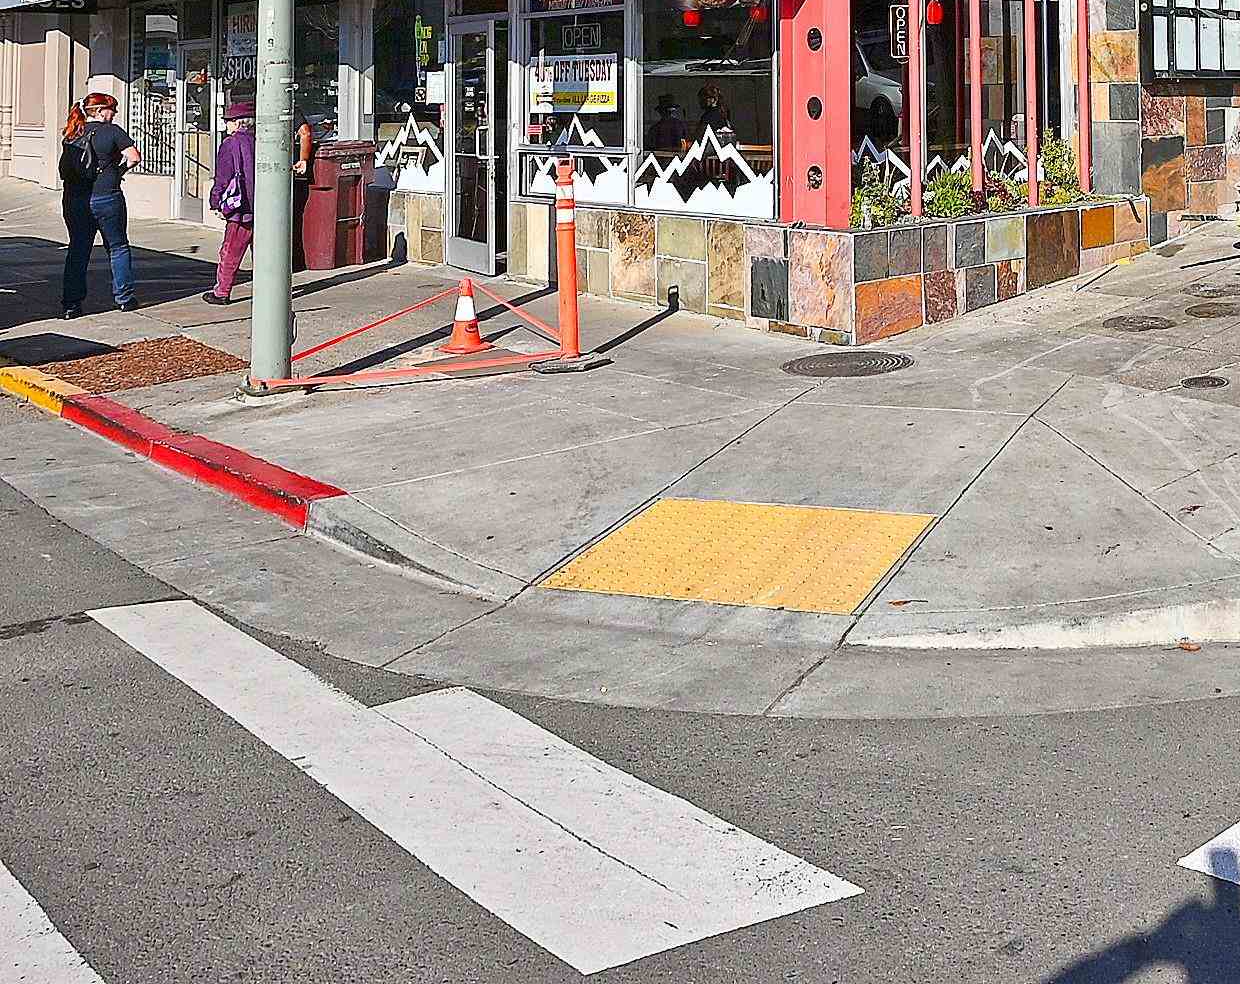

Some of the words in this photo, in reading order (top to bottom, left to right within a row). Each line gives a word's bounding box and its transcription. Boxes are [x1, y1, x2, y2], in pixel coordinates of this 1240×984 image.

[564, 26, 600, 47] OPEN
[896, 7, 906, 56] OPEN
[554, 61, 571, 82] OFF
[573, 59, 613, 82] TUESDAY
